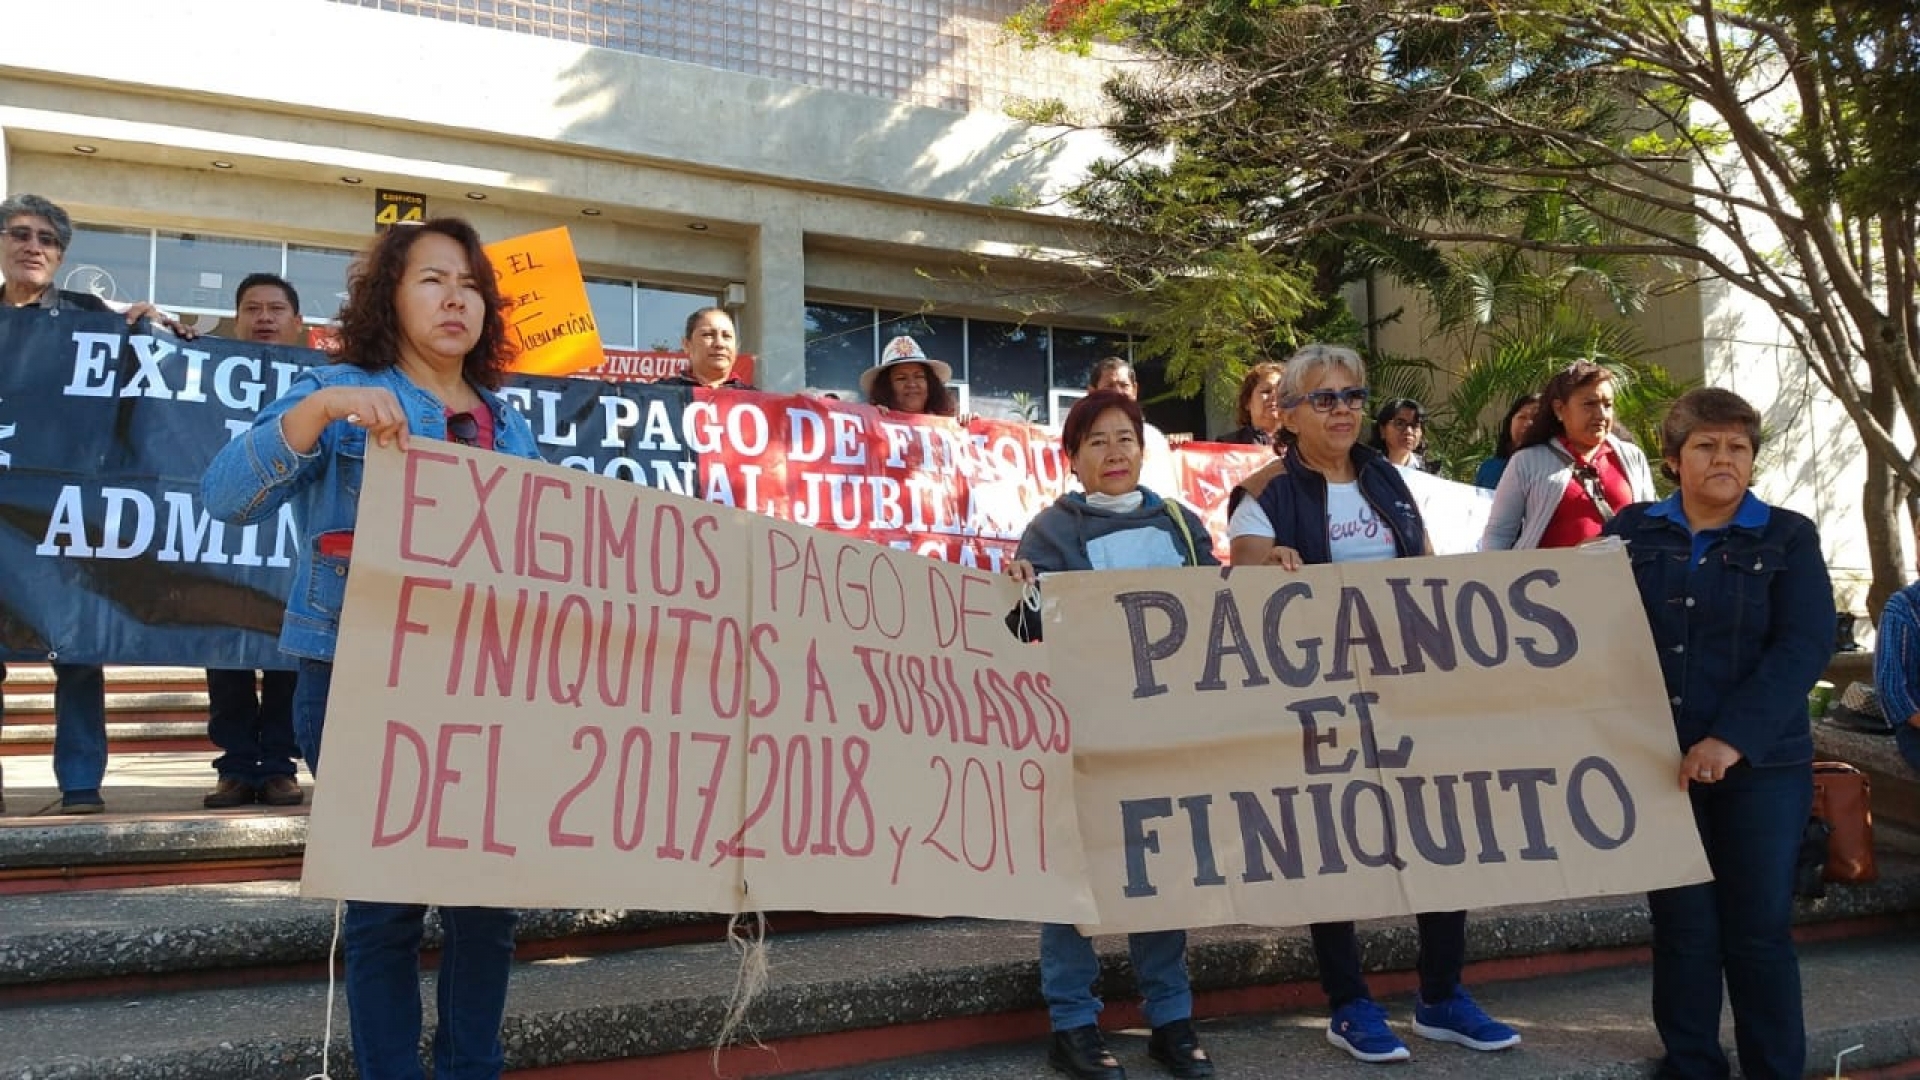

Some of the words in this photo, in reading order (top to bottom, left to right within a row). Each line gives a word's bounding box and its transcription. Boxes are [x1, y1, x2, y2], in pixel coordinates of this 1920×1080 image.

[376, 203, 422, 225] 44
[506, 251, 544, 274] EL
[599, 395, 770, 457] PAGO
[786, 407, 867, 466] DE
[400, 449, 721, 600] EXIGIMOS
[768, 528, 905, 641] PAGO
[929, 565, 994, 657] DE
[387, 576, 781, 719] FINIQUITOS
[806, 639, 837, 723] A
[854, 645, 1070, 754] JUBILADOS
[1115, 567, 1580, 698] PÁGANOS
[372, 720, 516, 857] DEL
[921, 755, 1048, 875] 2019
[1286, 692, 1414, 775] EL
[1119, 756, 1636, 898] FINIQUITO
